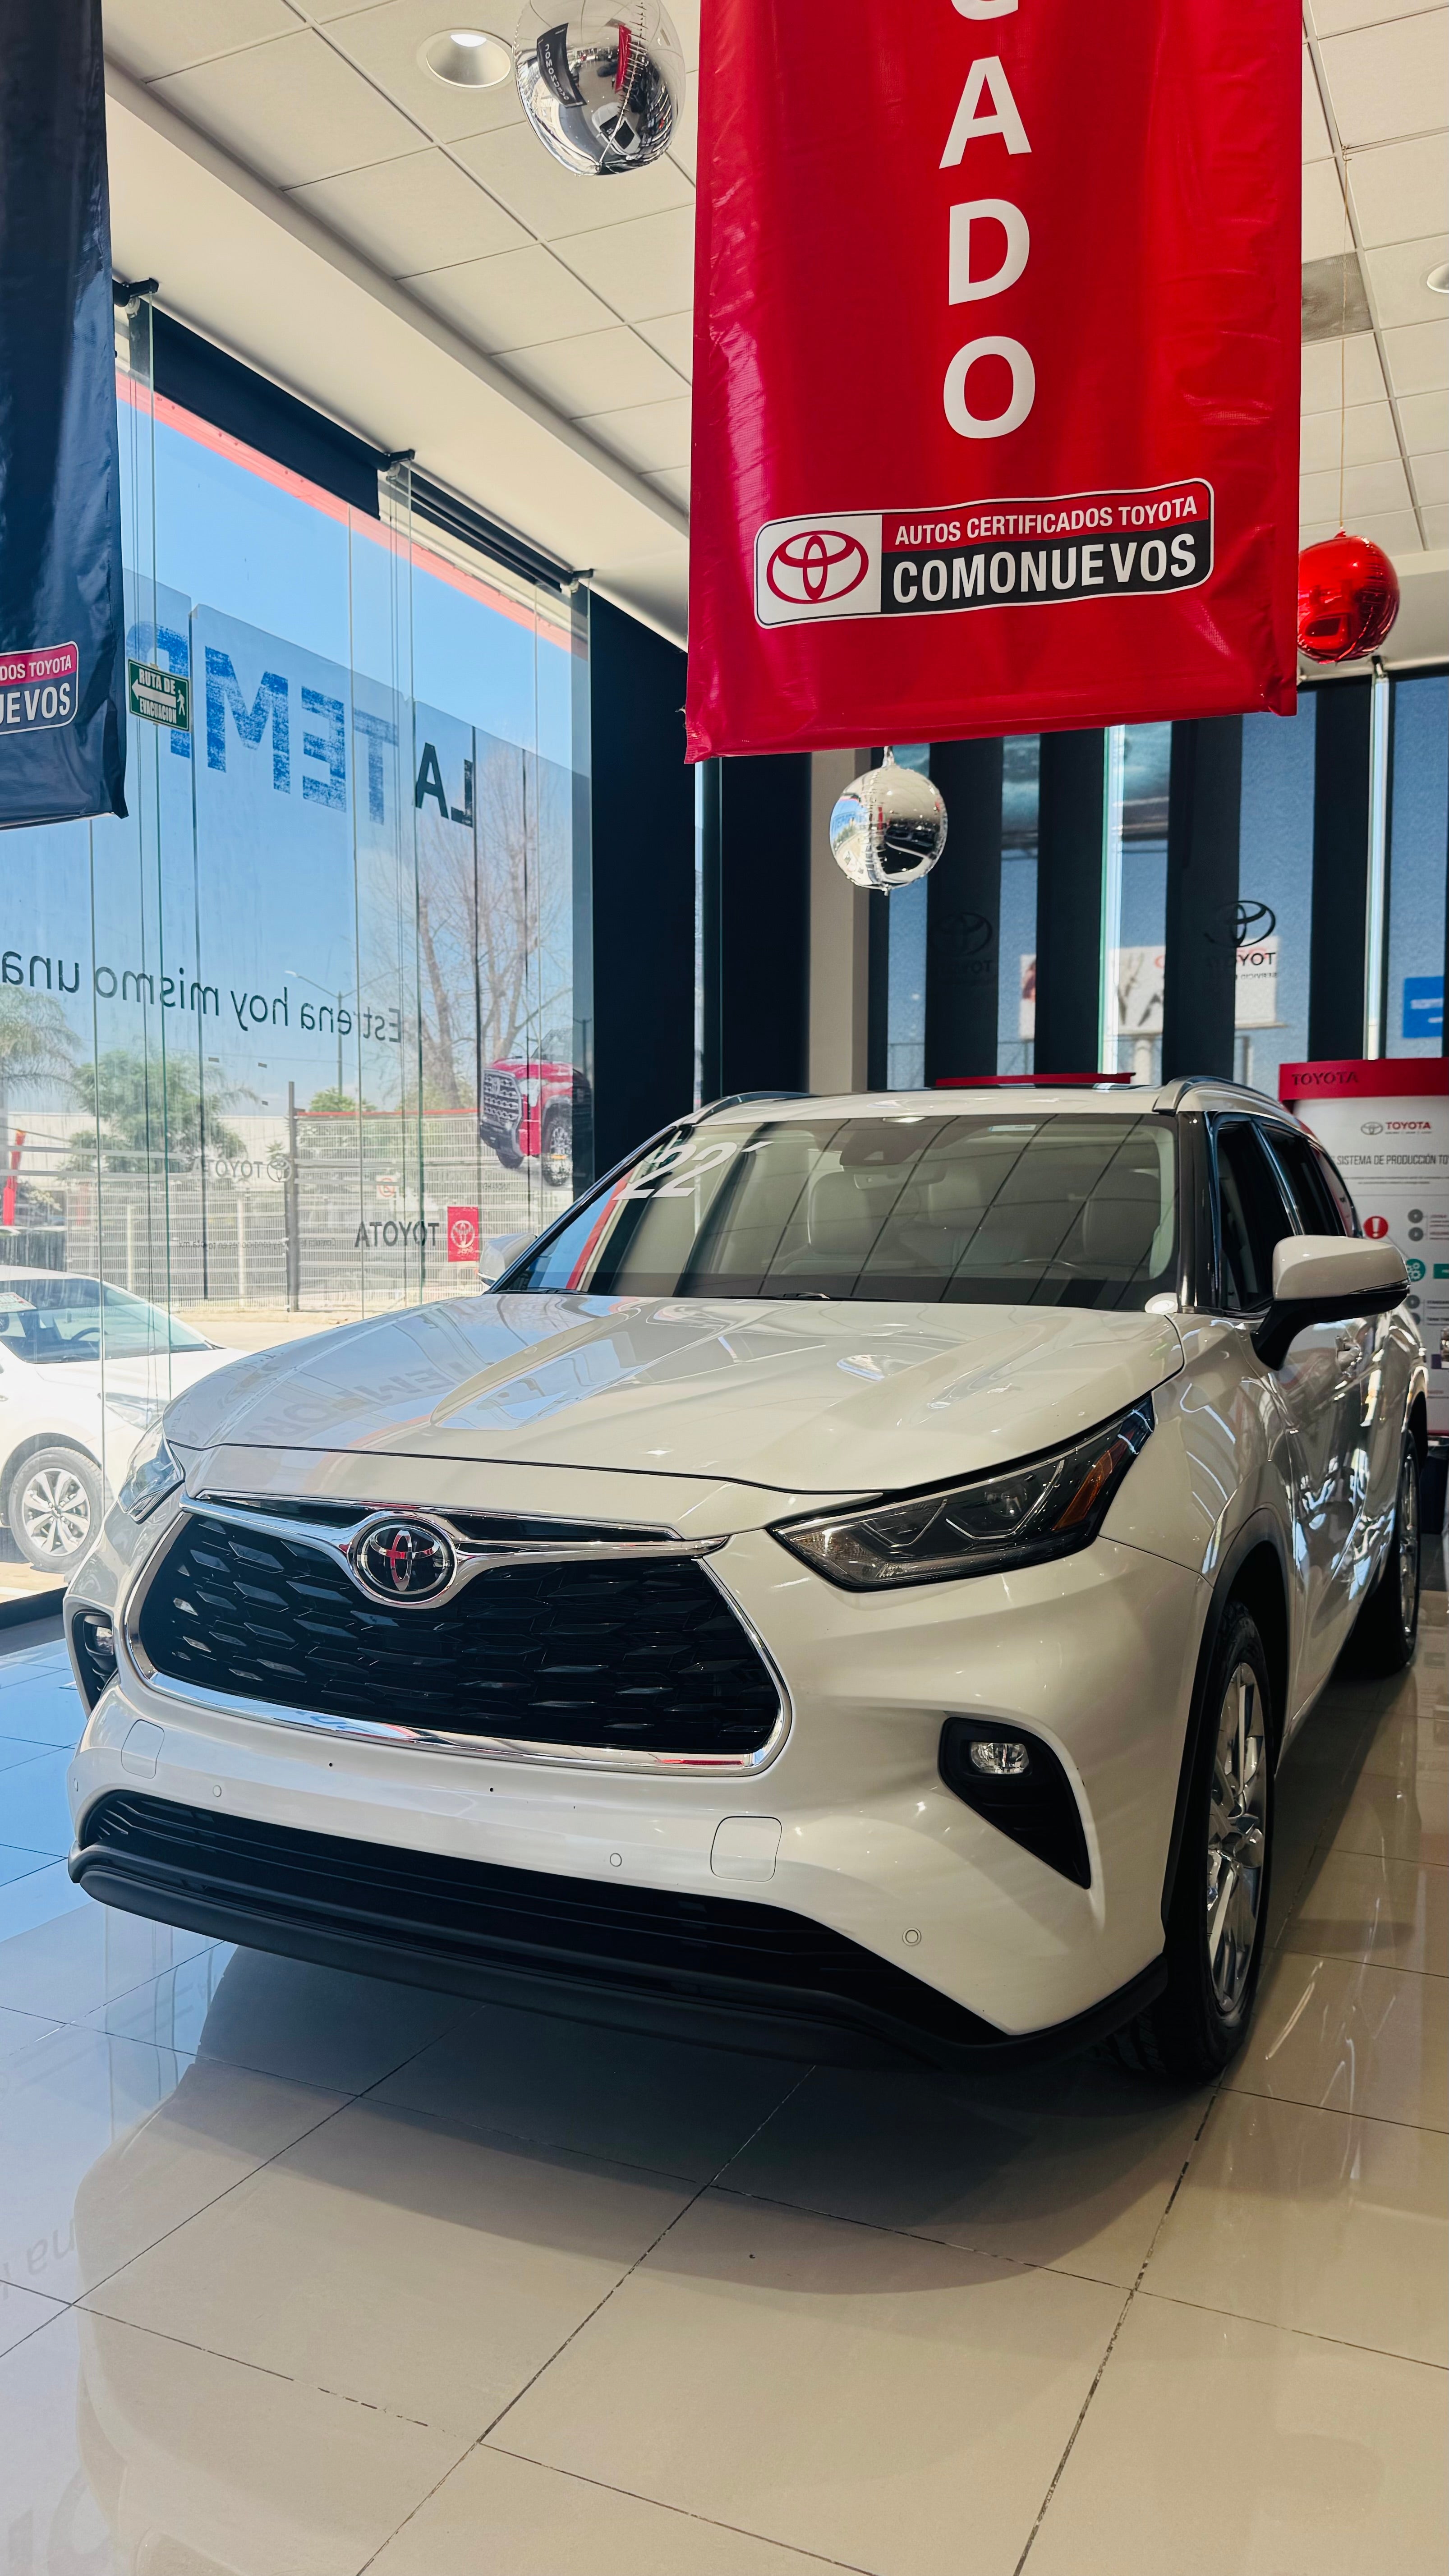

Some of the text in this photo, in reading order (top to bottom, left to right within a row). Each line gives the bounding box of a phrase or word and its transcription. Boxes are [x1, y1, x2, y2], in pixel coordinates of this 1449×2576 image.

[939, 0, 1035, 439] ADO
[895, 496, 1197, 545] AUTOS CERTIFICADOS TOYOTA
[893, 533, 1196, 603] COMONUEVOS
[0, 654, 72, 681] DOS TOYOTA
[139, 668, 176, 695] RUTA DE
[139, 698, 177, 724] EVACUACION
[1292, 1071, 1359, 1086] TOYOTA
[1385, 1121, 1431, 1130] TOYOTA
[1337, 1153, 1449, 1165] SISTEMA DE PRODUCCIÓN TO
